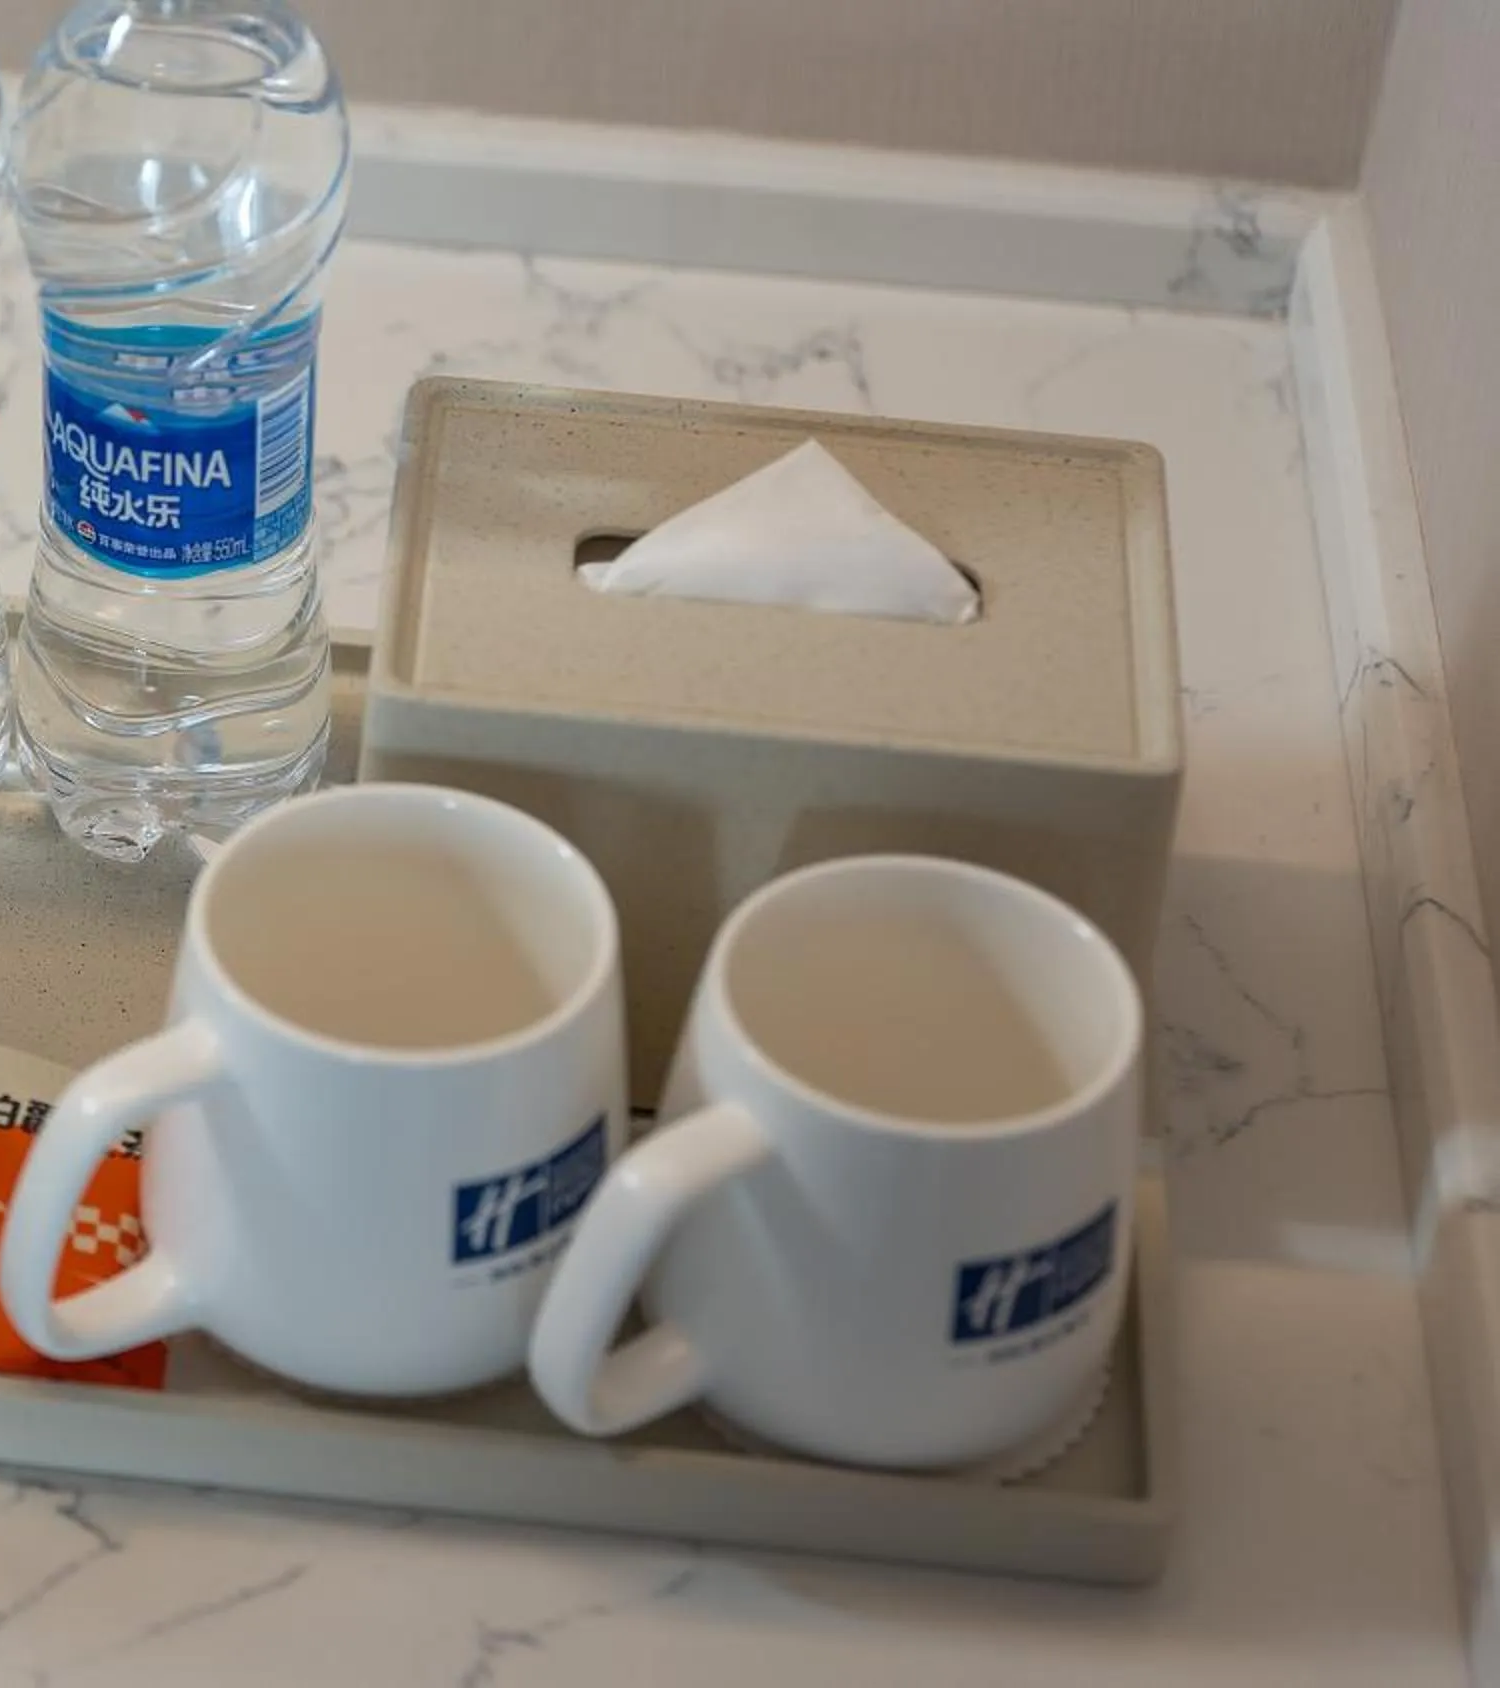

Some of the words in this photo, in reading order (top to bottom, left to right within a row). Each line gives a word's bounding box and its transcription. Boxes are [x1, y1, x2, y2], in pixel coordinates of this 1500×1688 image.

[52, 411, 232, 488] AQUAFINA
[80, 474, 181, 529] 纯水乐
